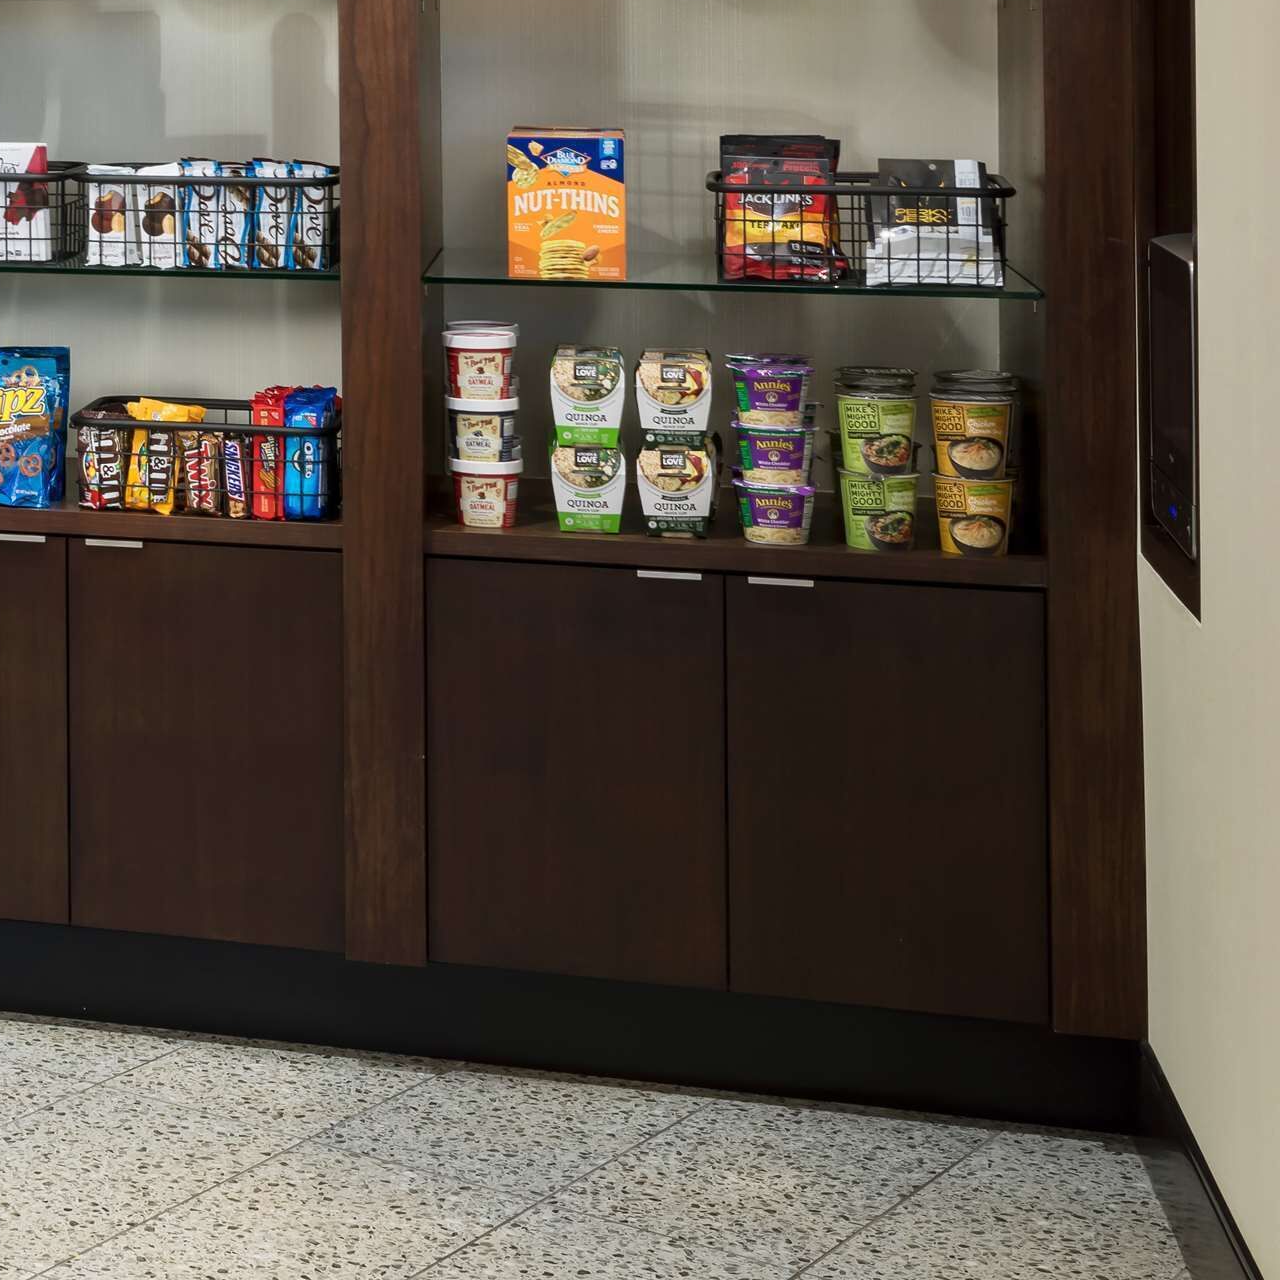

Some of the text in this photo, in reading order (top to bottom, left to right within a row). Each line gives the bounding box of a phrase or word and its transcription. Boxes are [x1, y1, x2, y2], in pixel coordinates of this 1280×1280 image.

[547, 157, 585, 165] DIAMOND
[514, 188, 620, 218] NUT-THINS
[738, 192, 772, 205] JACK
[575, 369, 597, 377] LOVE
[662, 371, 685, 379] LOVE
[845, 403, 877, 414] MIKE'S
[565, 413, 608, 423] QUINOA
[652, 416, 695, 425] QUINOA
[848, 420, 877, 429] GOOD
[465, 440, 491, 448] OATMEAL
[303, 442, 314, 479] OREO
[577, 456, 598, 464] LOVE
[662, 458, 685, 466] LOVE
[225, 439, 245, 501] SNICKERS
[850, 481, 882, 491] MIKE'S
[567, 499, 609, 509] QUINOA
[852, 497, 883, 506] GOOD
[469, 503, 496, 511] OATMEAL
[653, 503, 697, 512] QUINOA
